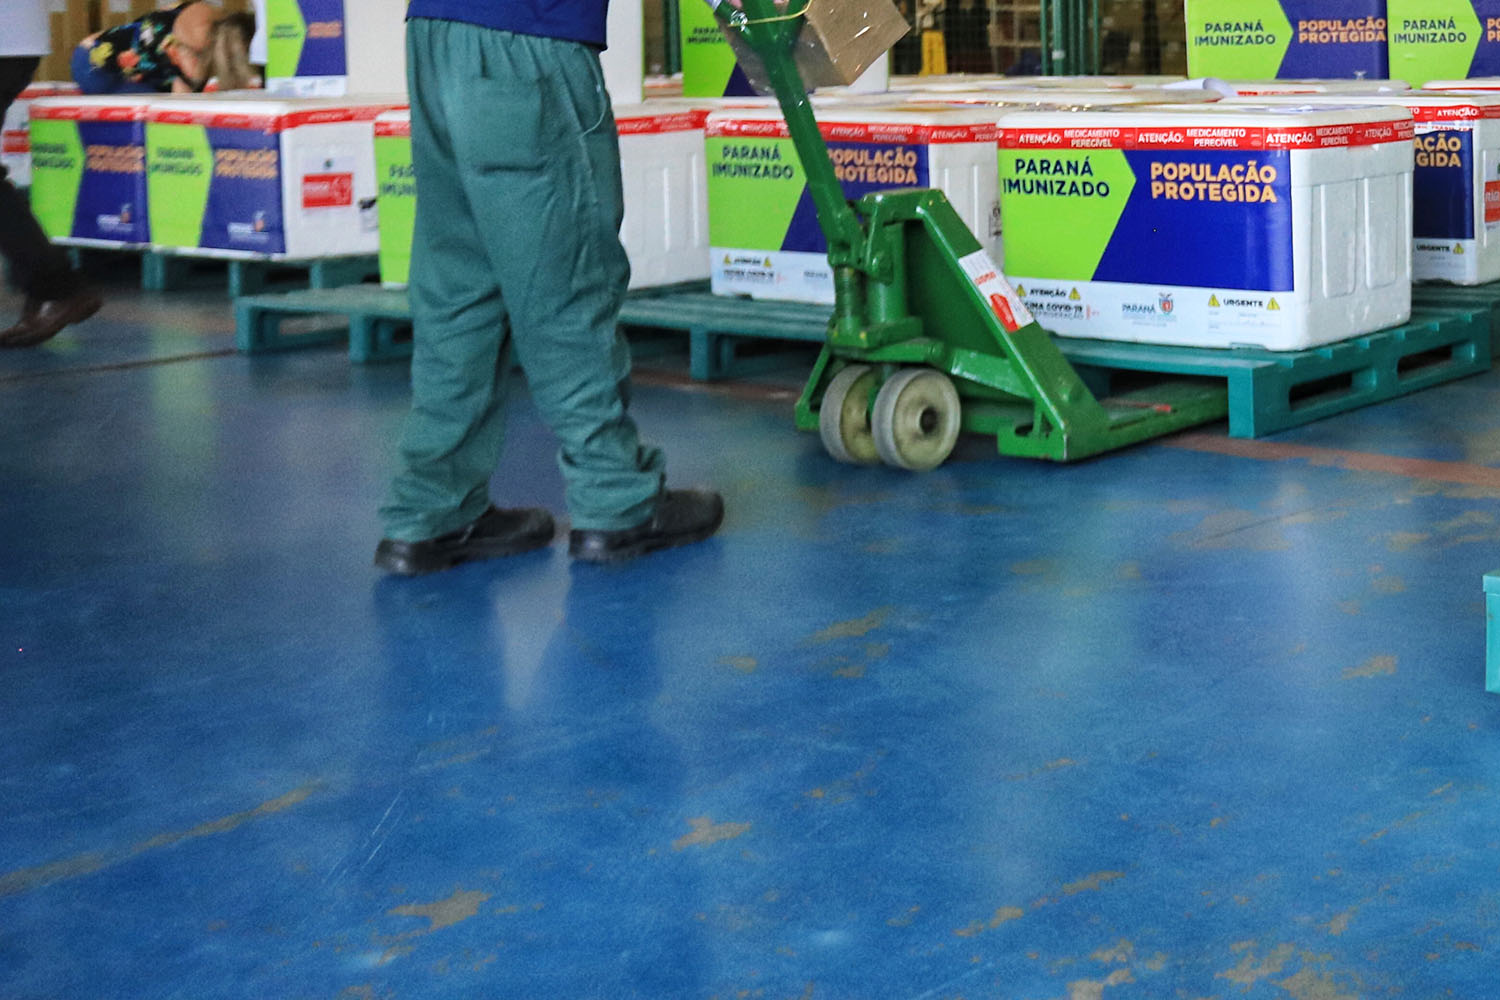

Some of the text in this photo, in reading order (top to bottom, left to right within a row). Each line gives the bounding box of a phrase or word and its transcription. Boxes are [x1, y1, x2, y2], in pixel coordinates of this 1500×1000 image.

[1205, 19, 1264, 33] PARANÁ
[1298, 16, 1386, 31] POPULAÇÃO
[1403, 16, 1456, 30] PARANÁ
[1195, 34, 1276, 47] IMUNIZADO
[1299, 30, 1386, 44] PROTEGIDA
[1394, 31, 1467, 44] IMUNIZADO
[1018, 128, 1120, 145] ATENÇÃO: MEDICAMENTO
[1071, 137, 1113, 148] PERECÍVEL
[1137, 128, 1246, 144] ATENÇÃO: MEDICAMENTO
[1193, 136, 1238, 147] PERECÍVEL
[722, 144, 782, 160] PARANÁ
[713, 163, 794, 179] IMUNIZADO
[1015, 156, 1093, 177] PARANÁ
[1150, 160, 1277, 184] POPULAÇÃO
[835, 166, 917, 184] ROTEGIDA
[1002, 178, 1110, 197] IMUNIZADO
[1150, 181, 1277, 203] PROTEGIDA
